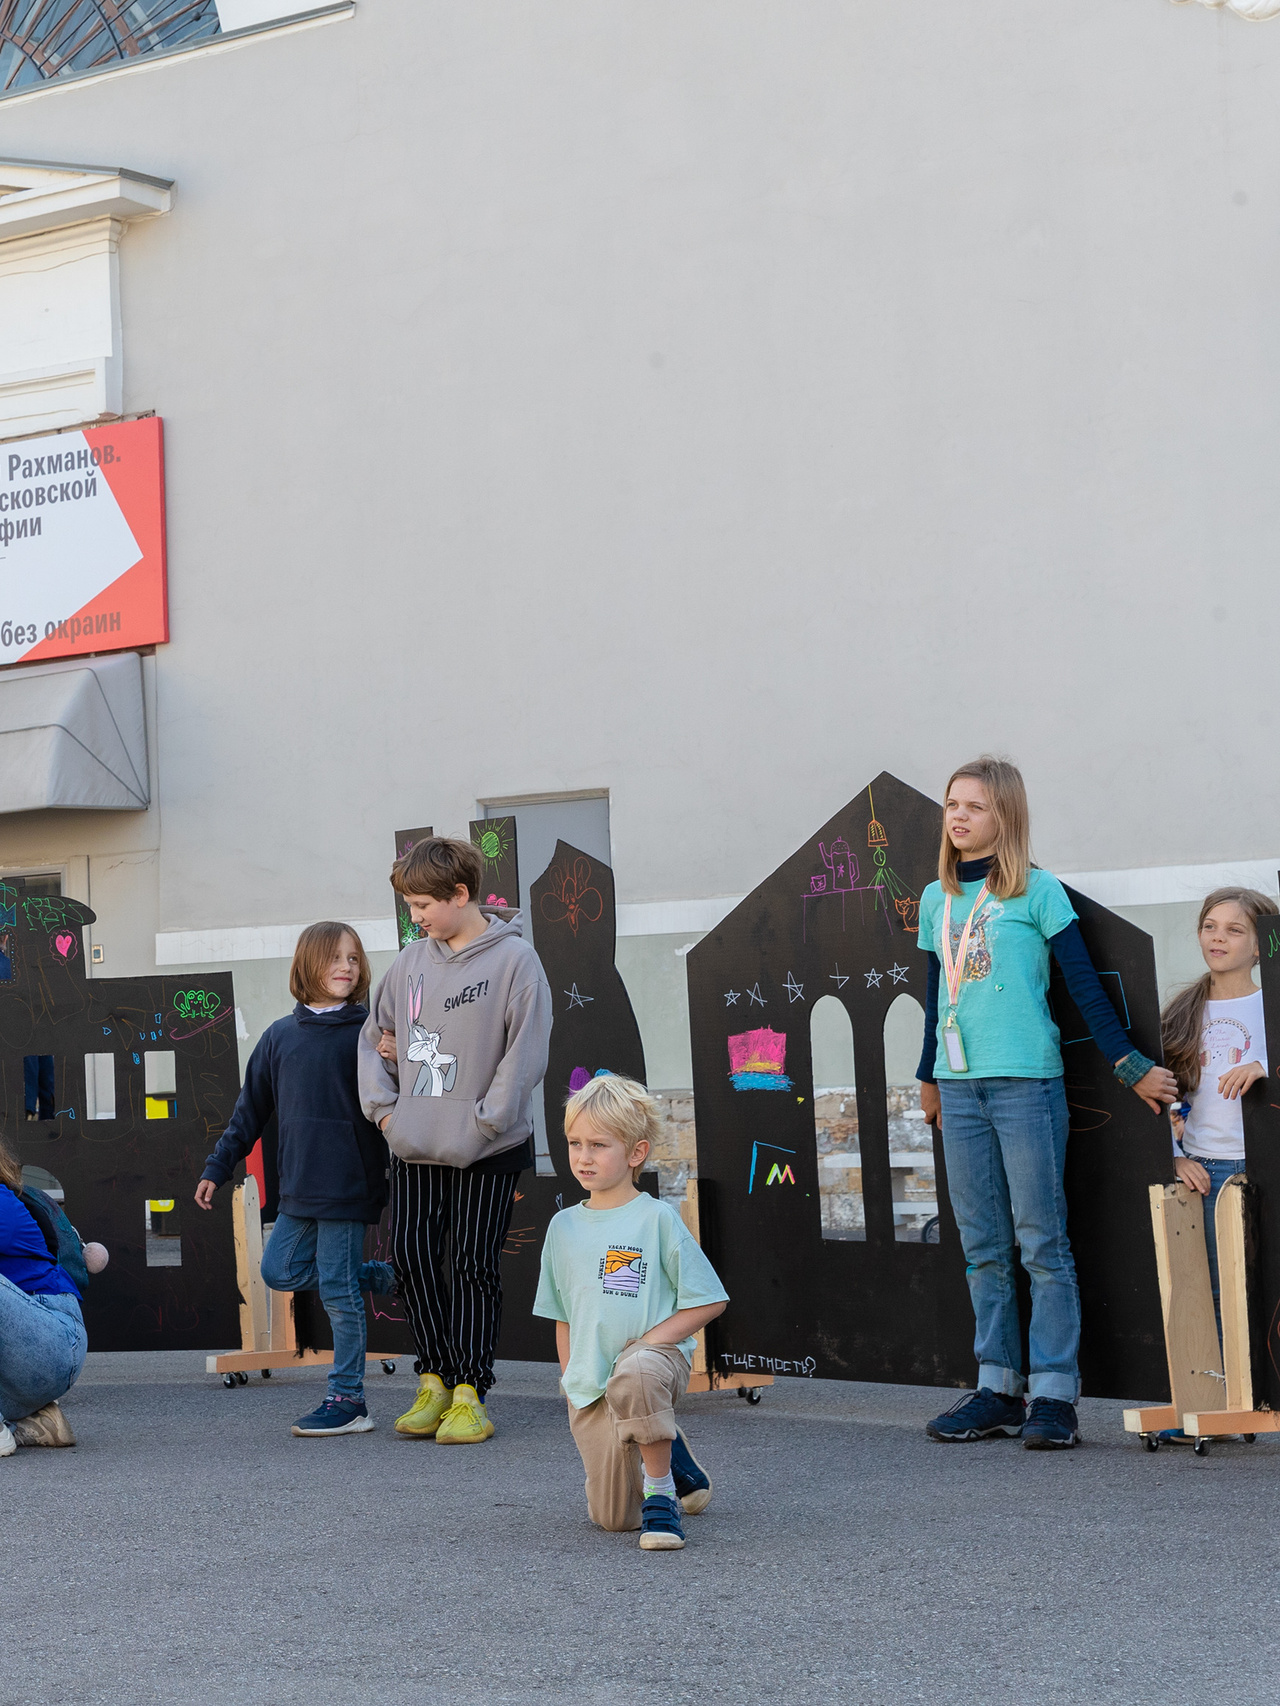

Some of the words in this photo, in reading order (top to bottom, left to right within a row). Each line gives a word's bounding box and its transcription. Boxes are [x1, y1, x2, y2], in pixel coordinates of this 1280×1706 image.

[8, 445, 121, 481] Рахманов.
[1, 620, 37, 647] без
[45, 612, 121, 644] окраин
[444, 979, 489, 1012] SWEET!
[640, 1262, 648, 1285] PLEASE
[720, 1353, 817, 1378] ТЩЕТНОСТЬ?
